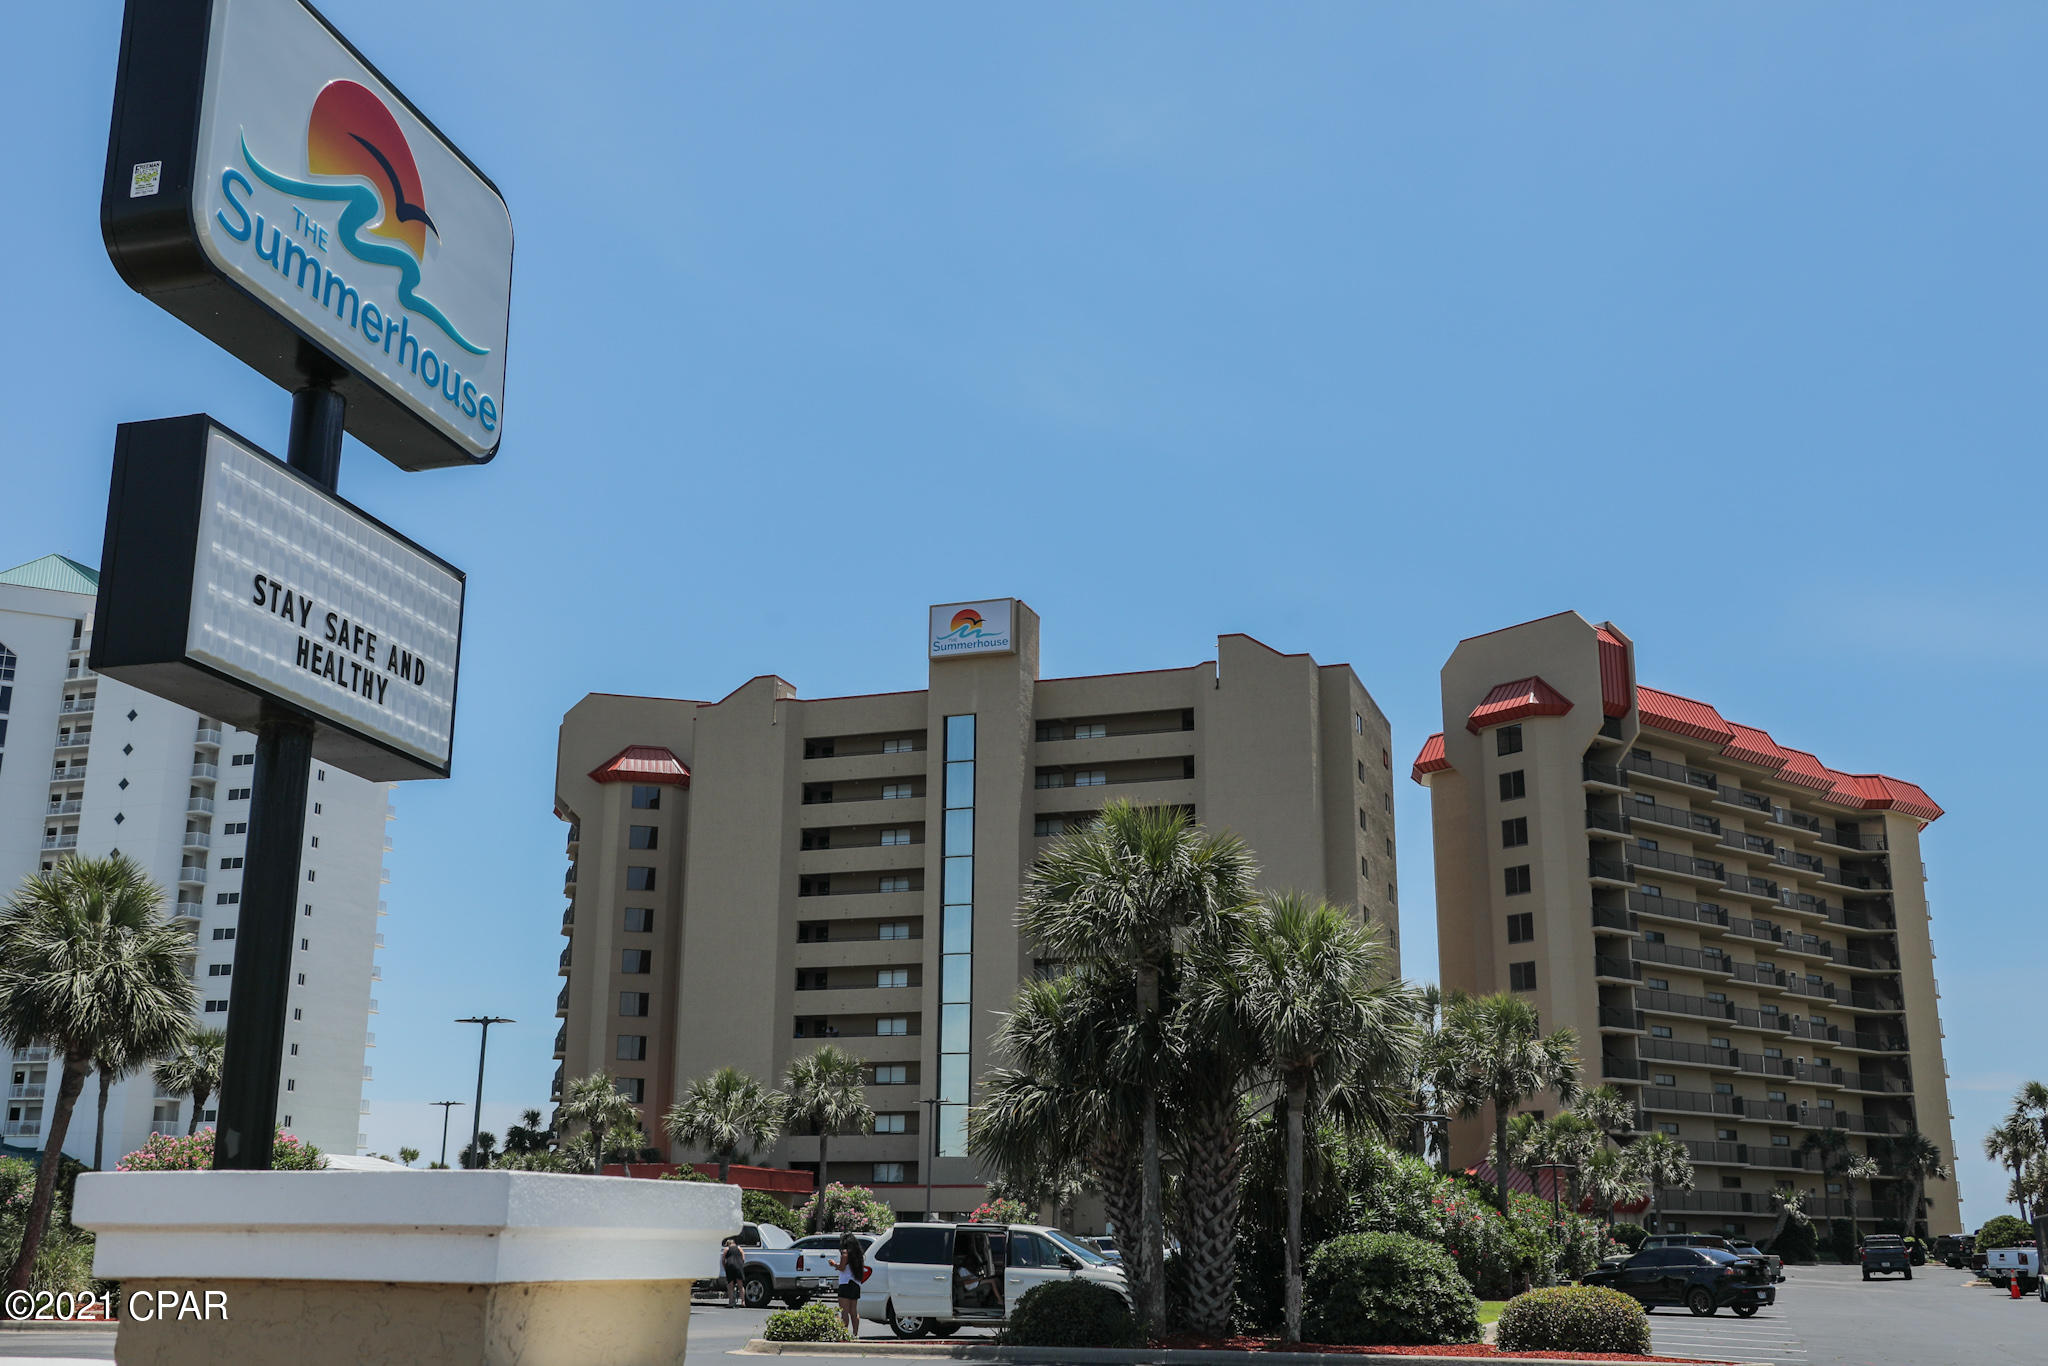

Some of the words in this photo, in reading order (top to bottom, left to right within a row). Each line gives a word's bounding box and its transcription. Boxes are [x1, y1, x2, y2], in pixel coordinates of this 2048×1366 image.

[293, 204, 329, 253] THE
[216, 168, 498, 432] Summerhouse
[253, 574, 313, 628] STAY
[325, 612, 377, 663] SAFE
[387, 644, 425, 686] AND
[933, 638, 1009, 652] Summerhouse
[296, 635, 388, 705] HEALTHY
